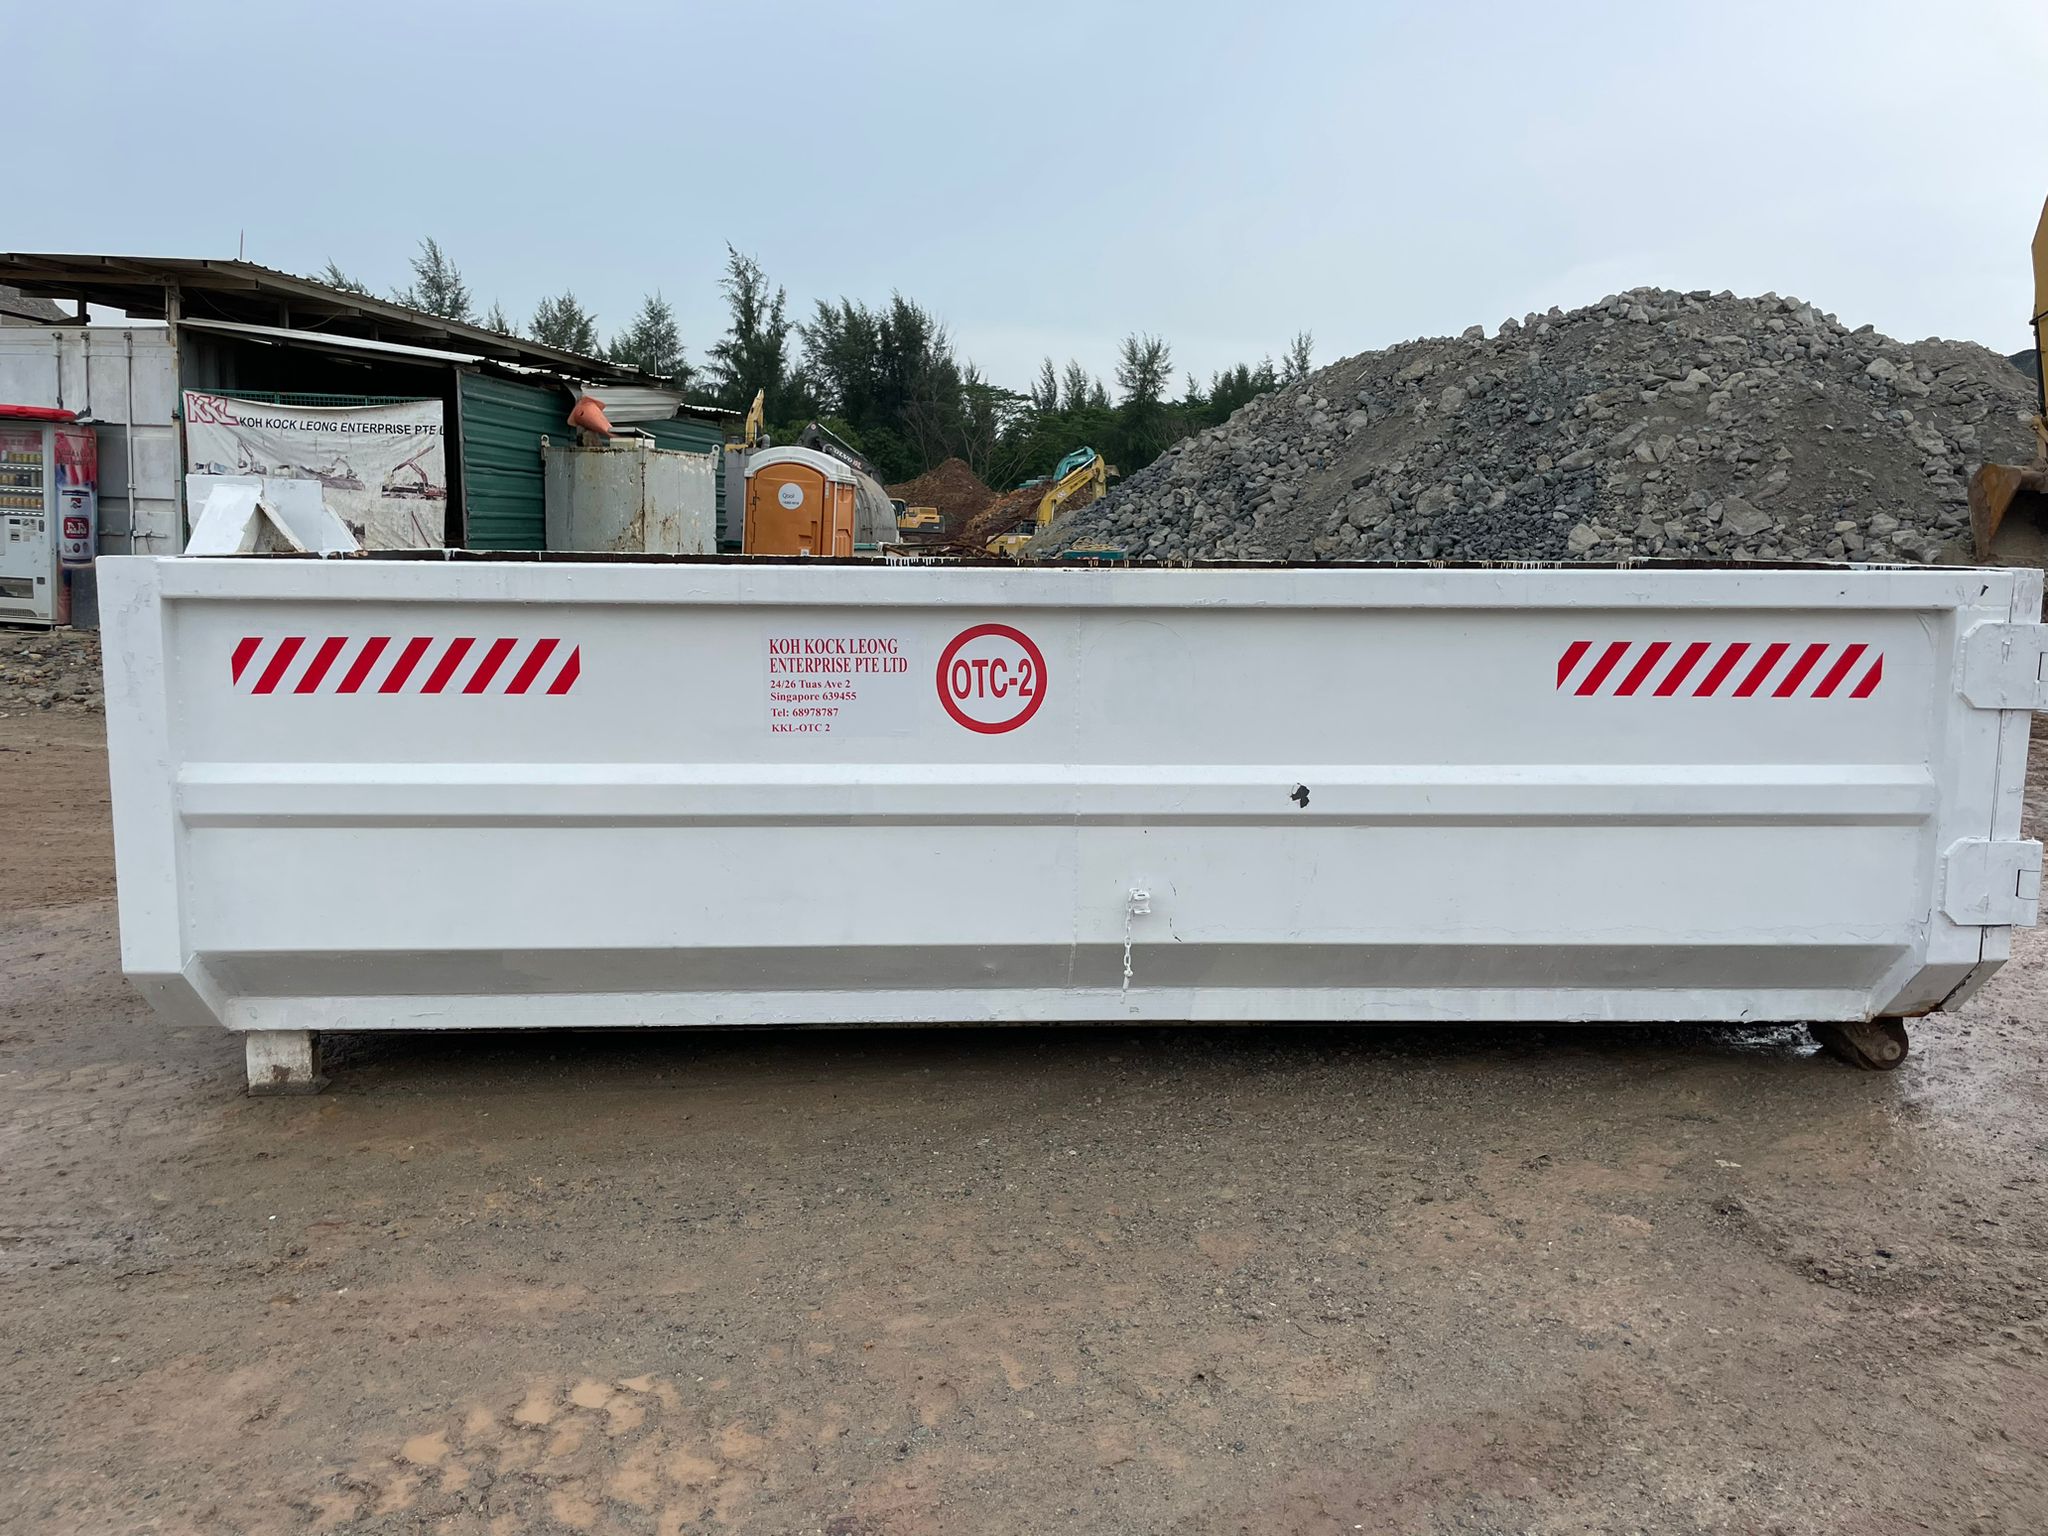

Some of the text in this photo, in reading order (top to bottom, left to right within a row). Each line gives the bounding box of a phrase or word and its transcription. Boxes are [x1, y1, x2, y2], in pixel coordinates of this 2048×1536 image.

[240, 417, 263, 428] KOH
[265, 418, 297, 430] KOCK
[300, 420, 338, 432] LEONG
[340, 423, 411, 435] ENTERPRISE
[414, 424, 437, 435] PTE
[769, 638, 898, 654] KOH KOCK LEONG
[769, 657, 908, 673] ENTERPRISE PTE LTD
[770, 680, 851, 689] 24/26 Tuas Ave 2
[952, 658, 1032, 699] OTC-2
[770, 692, 857, 703] Singapore 639455
[771, 708, 839, 717] Tel: 68978787
[772, 723, 831, 732] KKL-OTC 2
